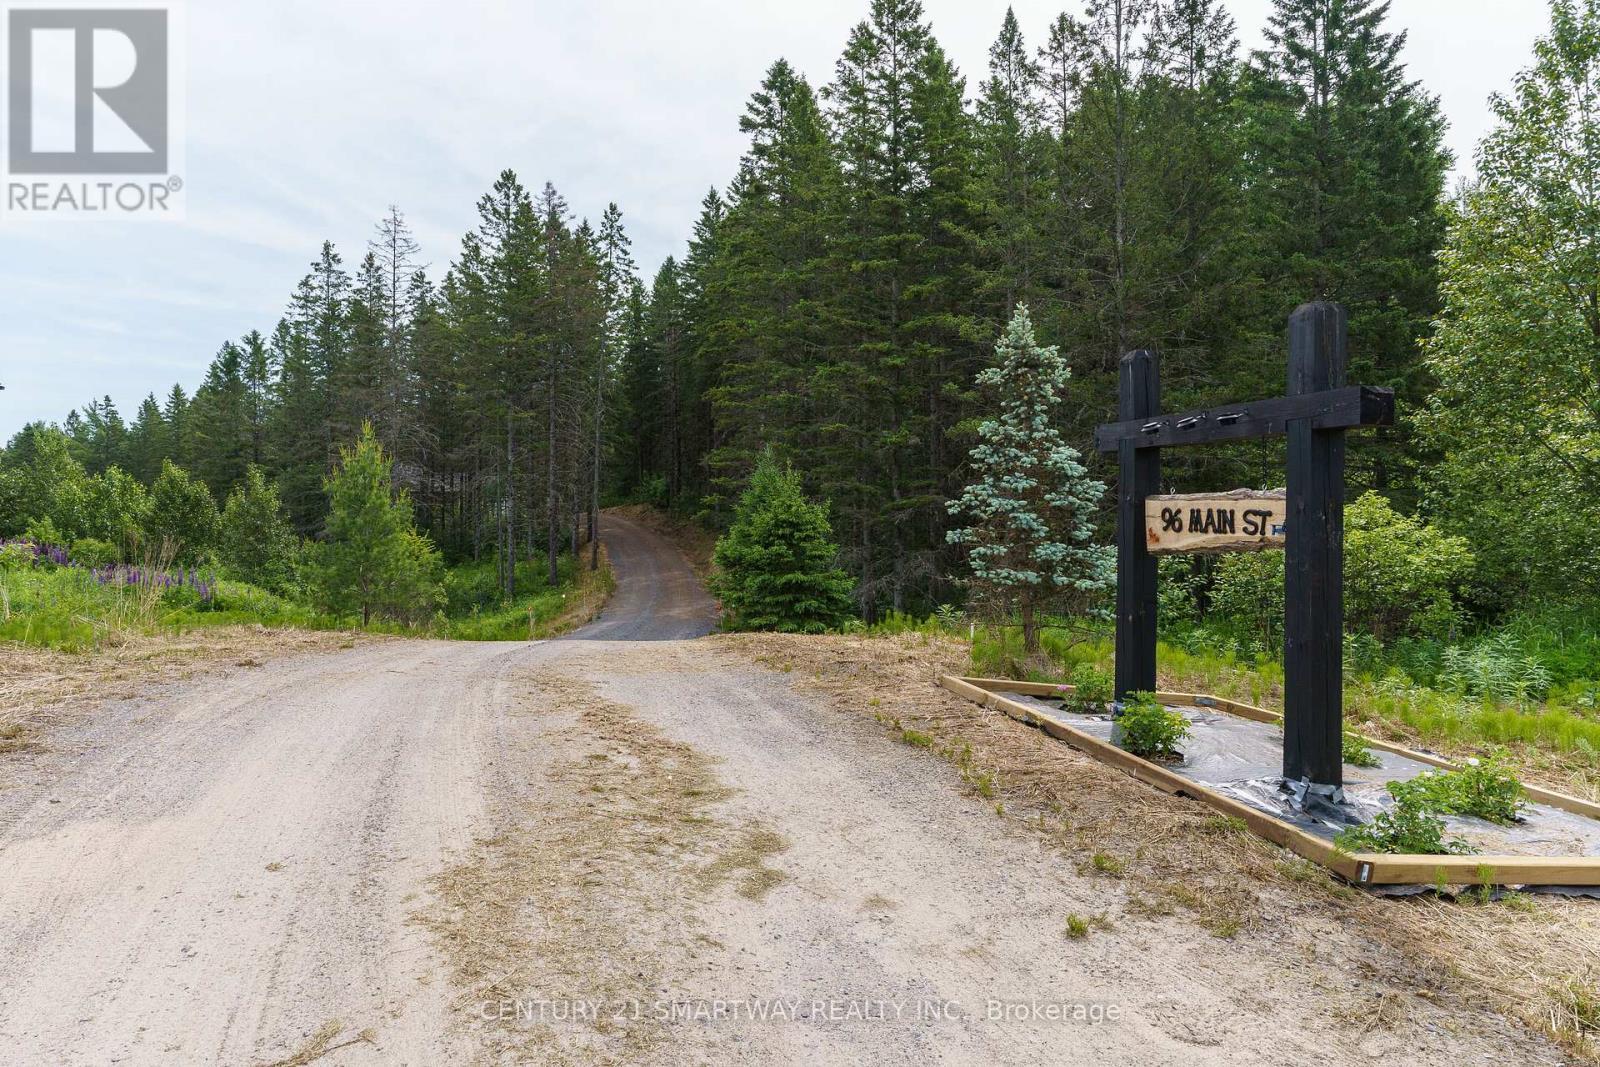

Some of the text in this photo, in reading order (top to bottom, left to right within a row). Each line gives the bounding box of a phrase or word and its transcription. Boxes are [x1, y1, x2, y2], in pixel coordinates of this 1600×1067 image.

[1161, 507, 1183, 533] 96
[1188, 507, 1236, 534] MAIN
[1242, 509, 1273, 536] ST
